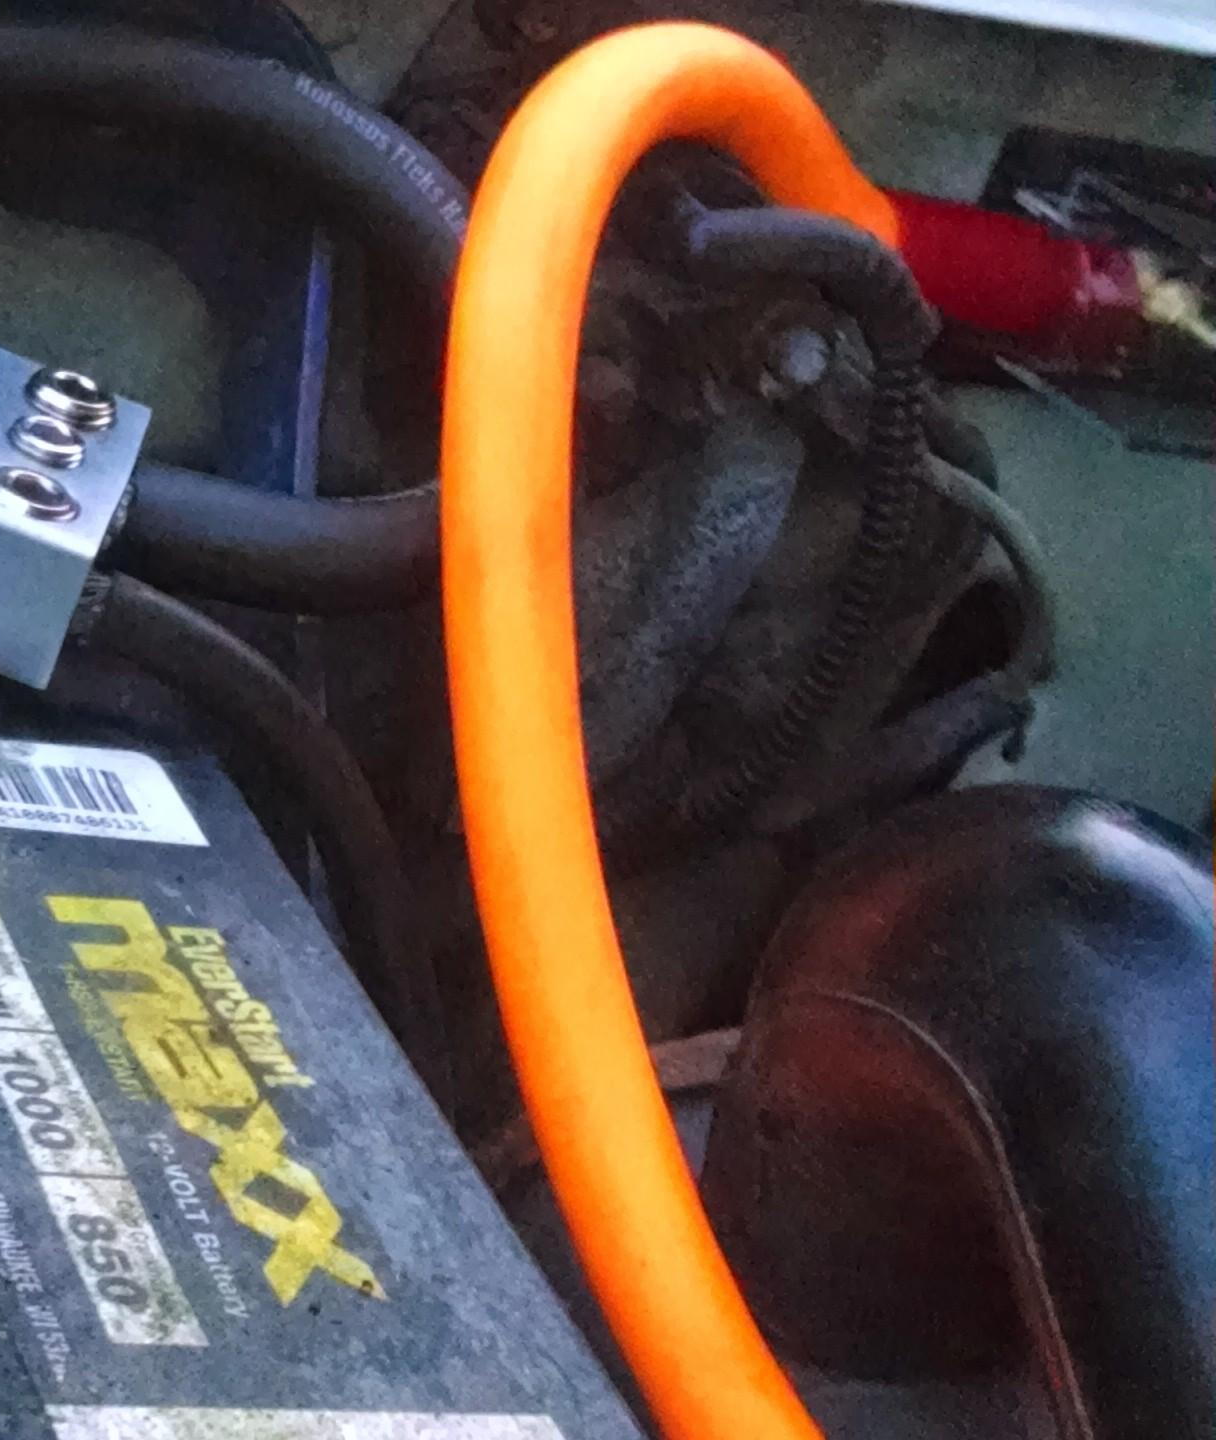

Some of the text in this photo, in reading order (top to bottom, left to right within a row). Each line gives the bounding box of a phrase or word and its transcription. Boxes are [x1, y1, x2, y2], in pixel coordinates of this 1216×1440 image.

[165, 925, 318, 1086] EverStart
[62, 1212, 155, 1308] 850
[139, 1129, 212, 1224] 12-VOLT
[185, 1231, 257, 1318] Battery
